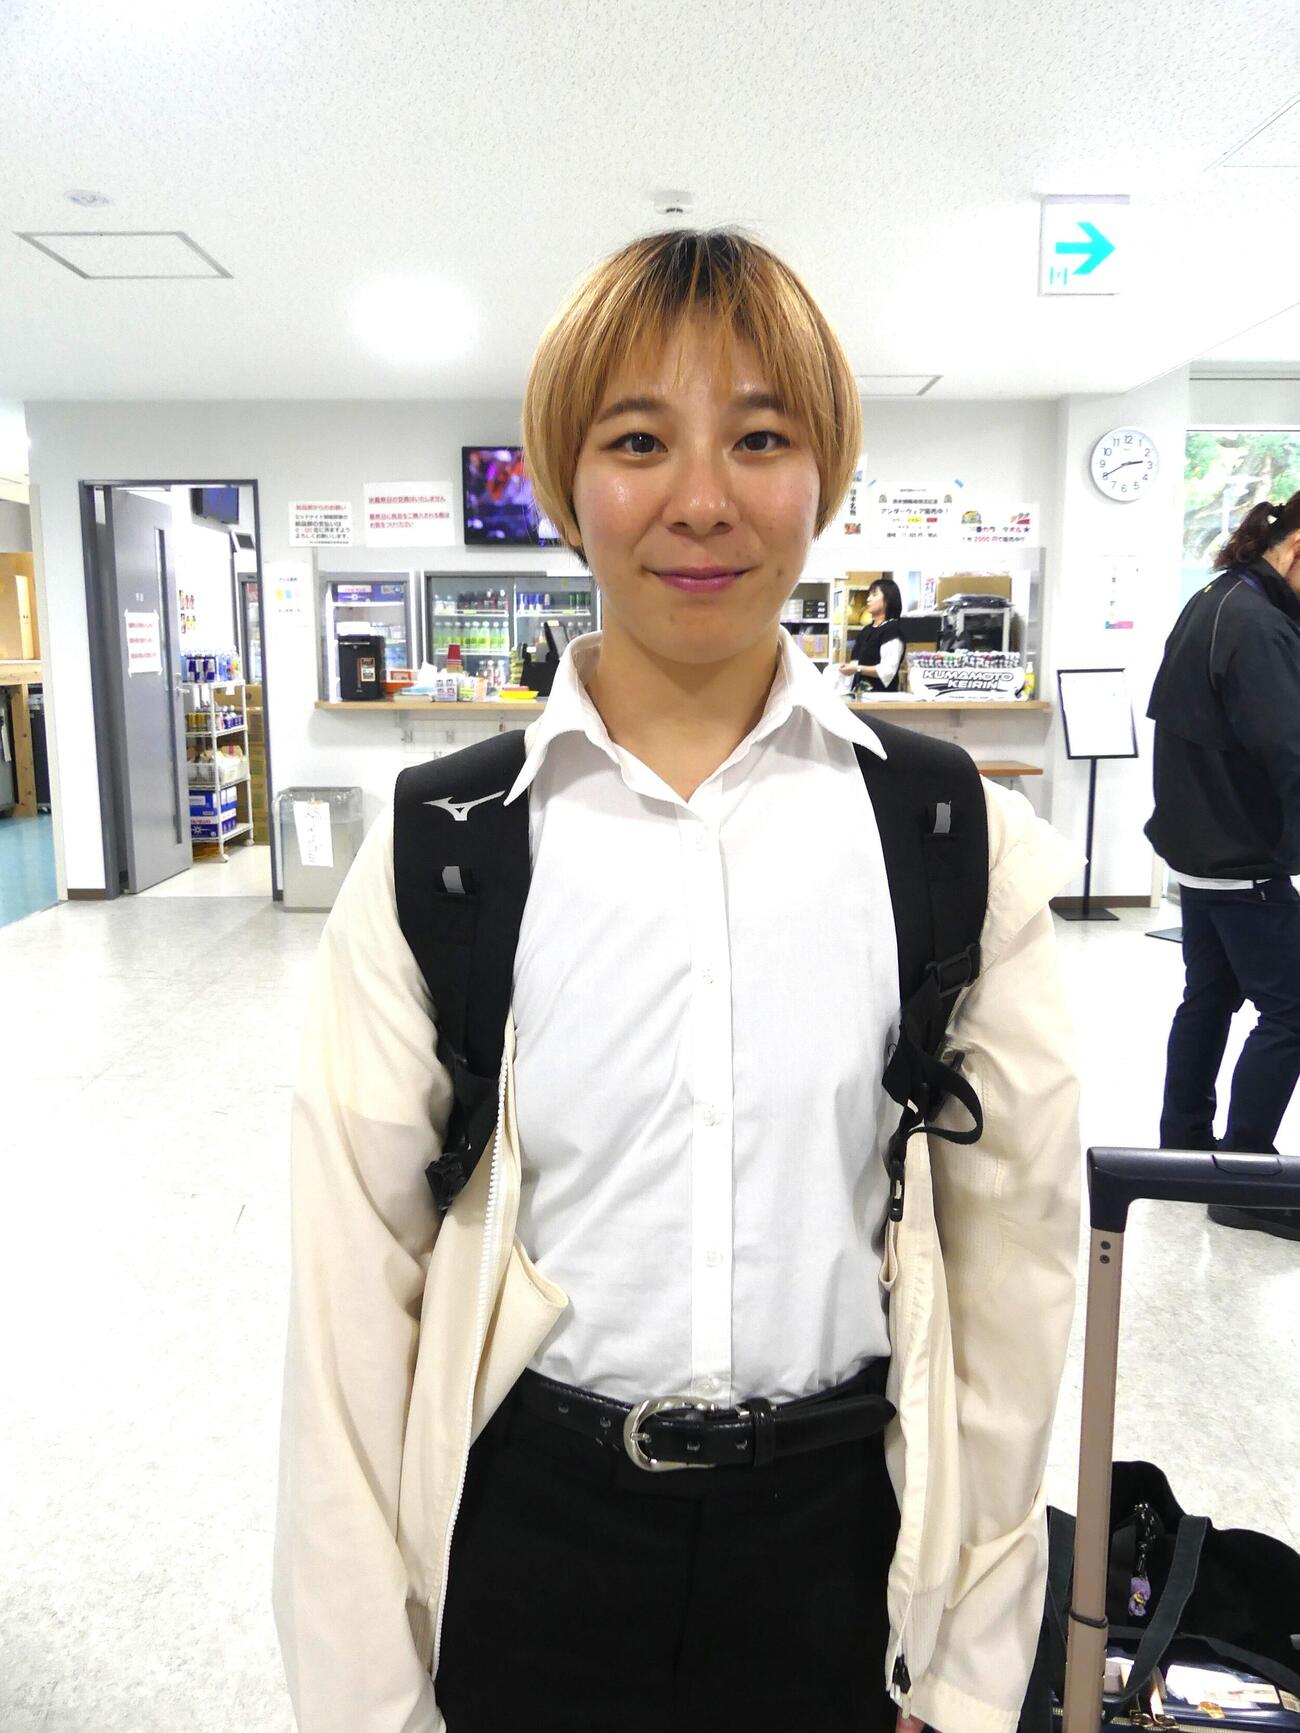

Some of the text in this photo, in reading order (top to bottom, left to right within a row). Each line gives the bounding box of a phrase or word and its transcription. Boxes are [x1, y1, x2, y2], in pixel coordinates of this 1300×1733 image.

[1112, 438, 1120, 447] 11
[1124, 434, 1133, 444] 12
[1138, 439, 1142, 448] 1
[1103, 447, 1112, 457] 10
[1144, 447, 1151, 457] 2
[1100, 459, 1106, 468] 9
[1146, 460, 1153, 470] 3
[1142, 473, 1148, 481] 4
[1111, 480, 1117, 489] 7
[1121, 484, 1127, 493] 6
[1133, 481, 1140, 490] 5
[923, 670, 1014, 681] KUMAMOTO
[947, 679, 999, 690] KEIRIN
